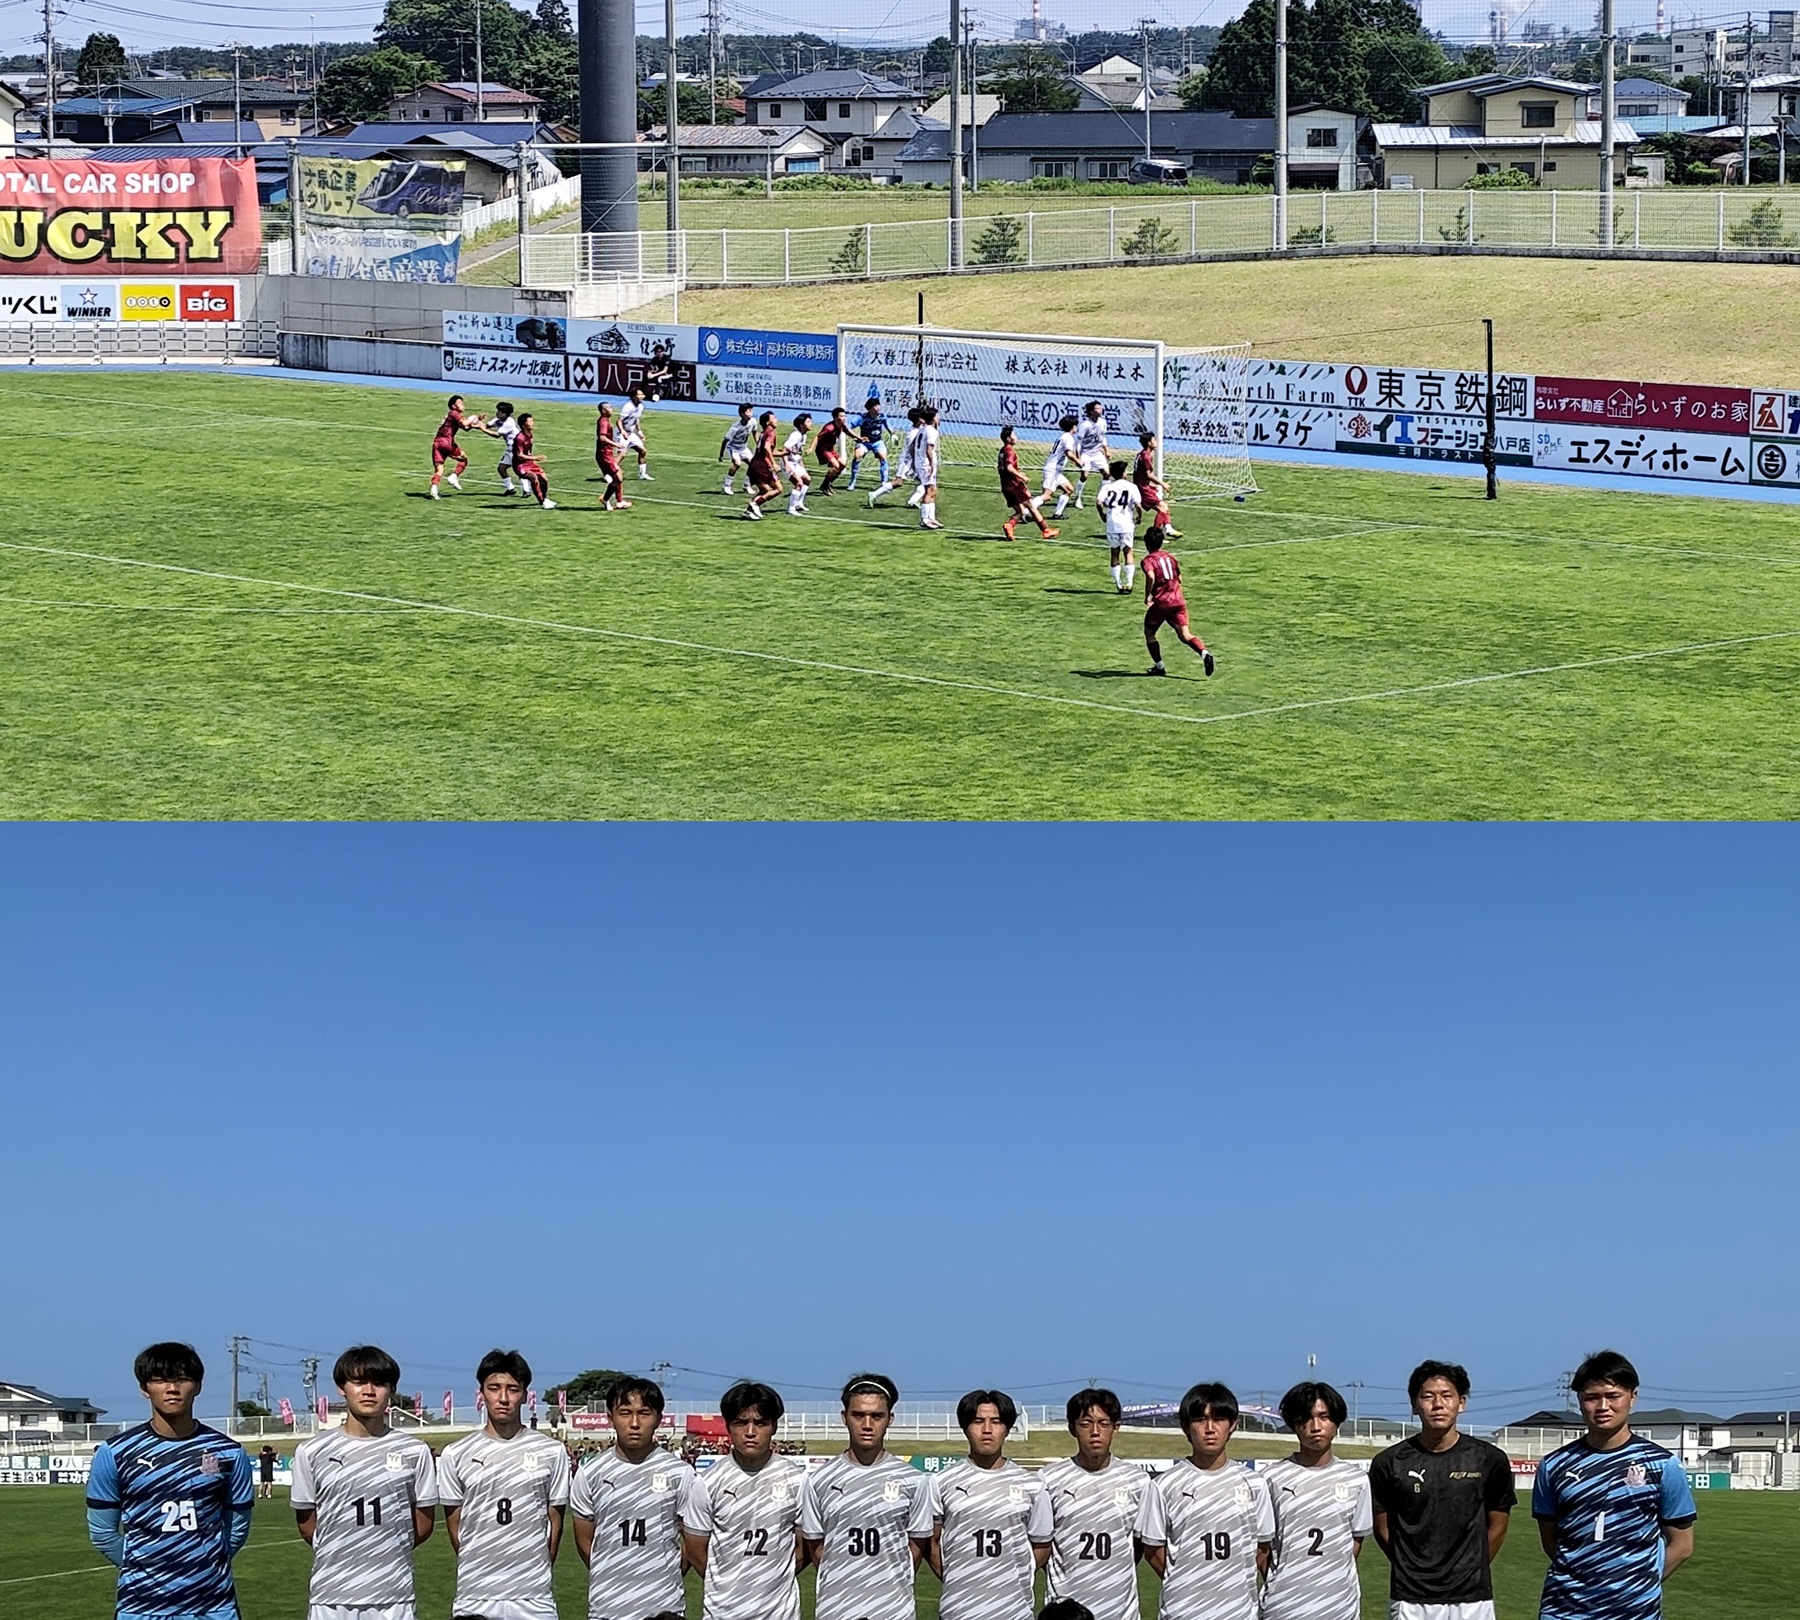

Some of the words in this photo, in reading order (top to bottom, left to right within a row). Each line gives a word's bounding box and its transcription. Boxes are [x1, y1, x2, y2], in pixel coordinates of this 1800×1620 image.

[63, 172, 118, 194] CAR
[124, 173, 197, 194] SHOP
[67, 306, 112, 318] WINNER
[1004, 356, 1069, 375] 株式会社
[1286, 382, 1335, 404] Farm
[1347, 397, 1366, 407] TTK
[1375, 370, 1528, 418] 東京鉄鋼
[1535, 396, 1606, 414] らいず不動産
[1634, 395, 1749, 423] らいずのお家
[1568, 433, 1745, 478] エスディホーム
[1108, 489, 1130, 510] 24
[1160, 556, 1174, 581] 11
[161, 1499, 197, 1533] 25
[351, 1497, 382, 1527] 11
[496, 1497, 512, 1526] 8
[619, 1519, 647, 1548] 14
[1594, 1511, 1606, 1542] 1
[743, 1528, 769, 1557] 22
[847, 1526, 881, 1558] 30
[972, 1529, 1002, 1558] 13
[1079, 1532, 1111, 1560] 20
[1199, 1532, 1231, 1561] 19
[1307, 1527, 1325, 1557] 2
